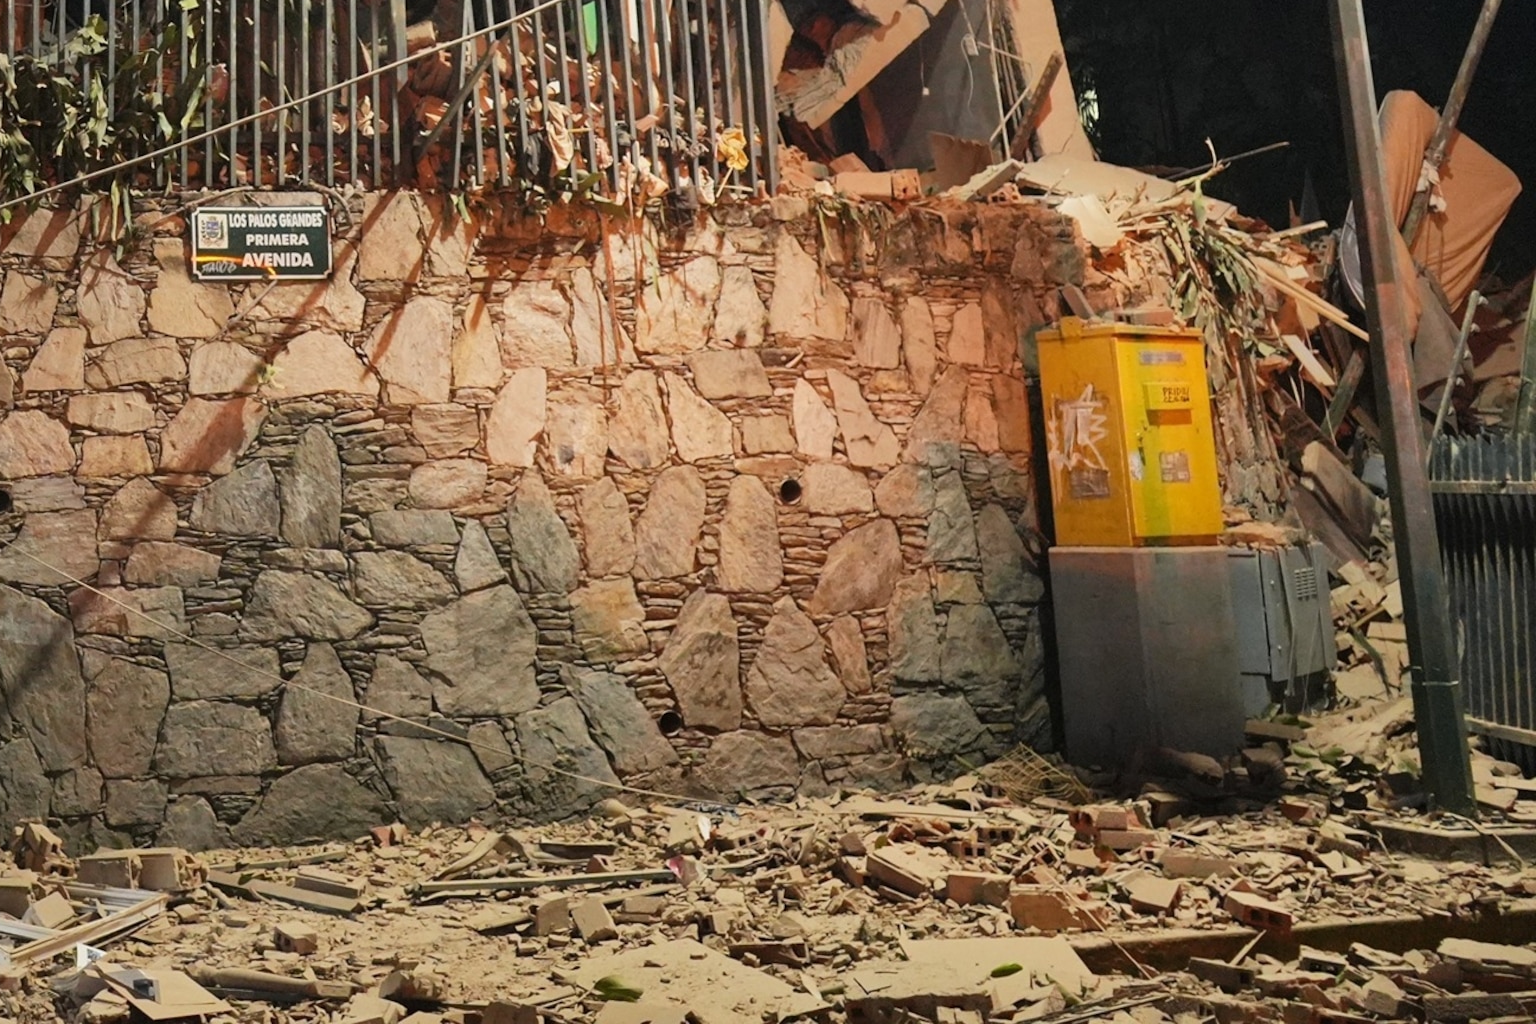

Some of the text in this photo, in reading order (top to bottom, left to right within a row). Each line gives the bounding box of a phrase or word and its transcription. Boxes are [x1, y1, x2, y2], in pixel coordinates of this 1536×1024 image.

[229, 212, 323, 228] LOS PALOS GRANDES
[246, 234, 309, 246] PRIMERA
[242, 252, 314, 267] AVENIDA
